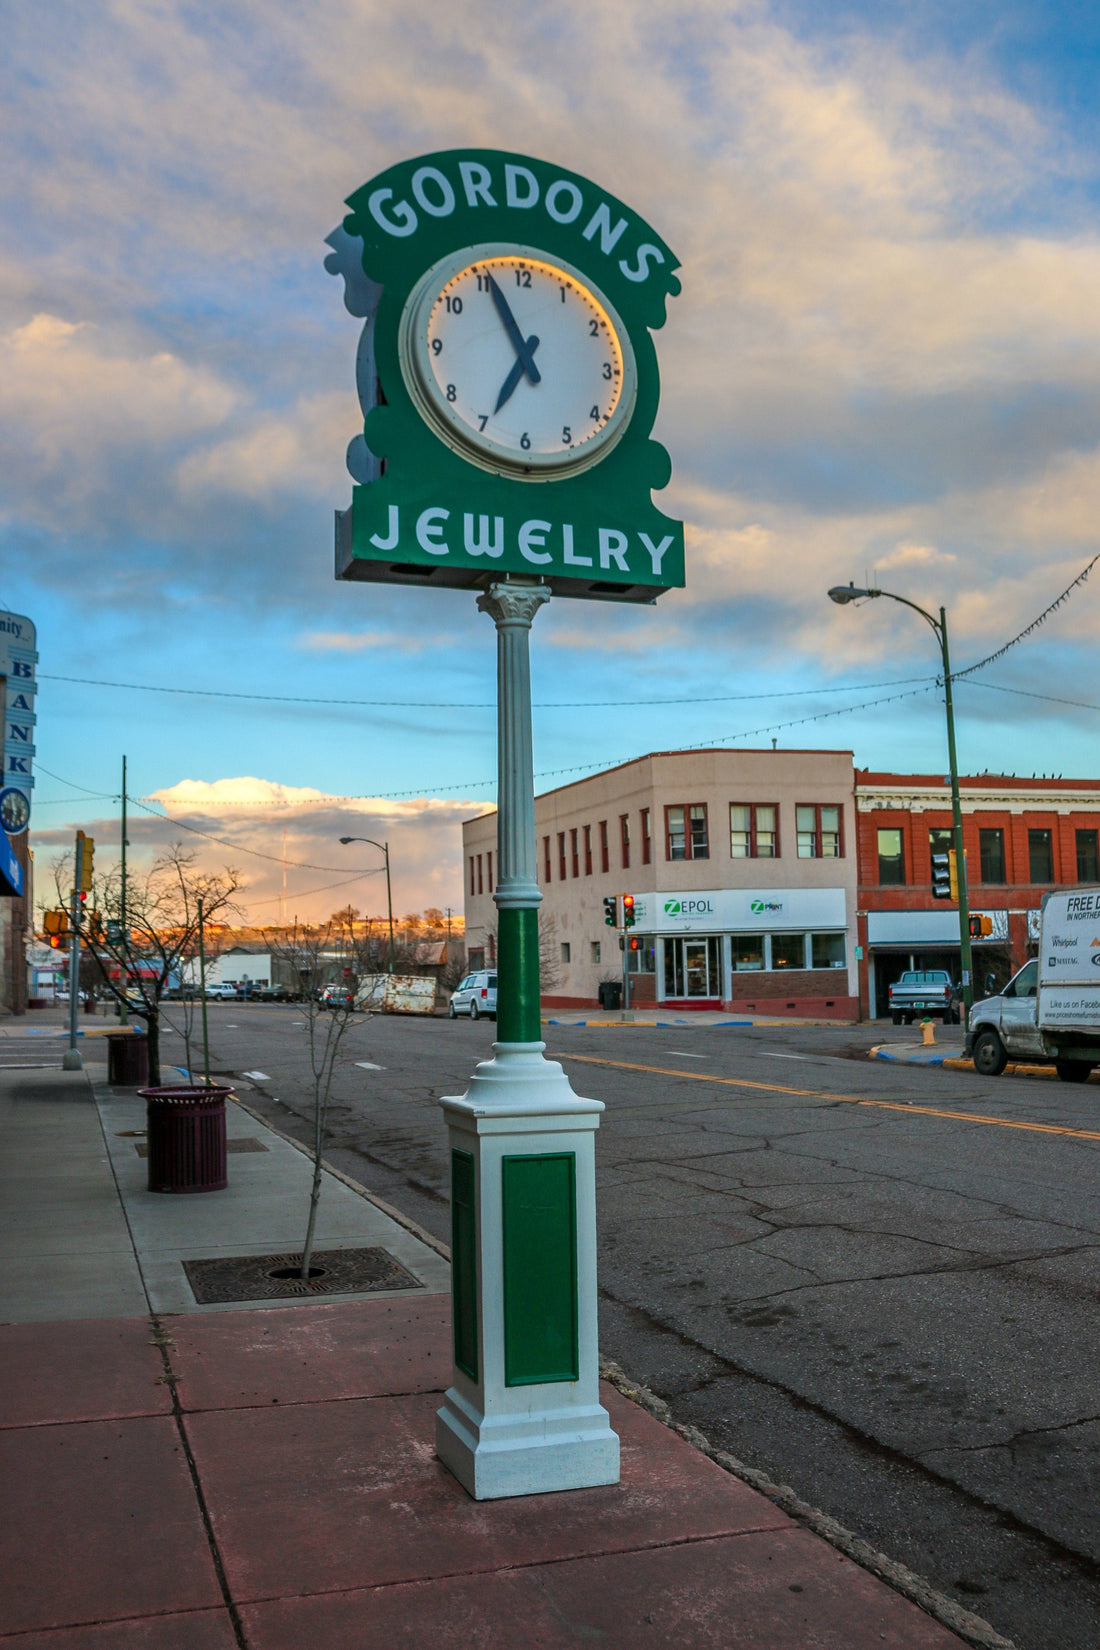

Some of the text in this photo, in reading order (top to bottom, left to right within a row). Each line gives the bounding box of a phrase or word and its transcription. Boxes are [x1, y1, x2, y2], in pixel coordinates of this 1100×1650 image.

[368, 161, 665, 283] GORDONS
[477, 275, 490, 293] 11
[515, 269, 532, 288] 12
[560, 287, 567, 304] 1
[446, 297, 463, 314] 10
[589, 320, 599, 337] 2
[431, 339, 443, 356] 9
[602, 363, 613, 380] 3
[446, 385, 457, 402] 8
[590, 405, 600, 422] 4
[478, 415, 489, 432] 7
[520, 433, 531, 450] 6
[562, 427, 572, 444] 5
[369, 504, 674, 575] JEWELRY
[8, 661, 32, 774] BANK
[1067, 896, 1094, 912] FREE
[1050, 1000, 1062, 1008] Like
